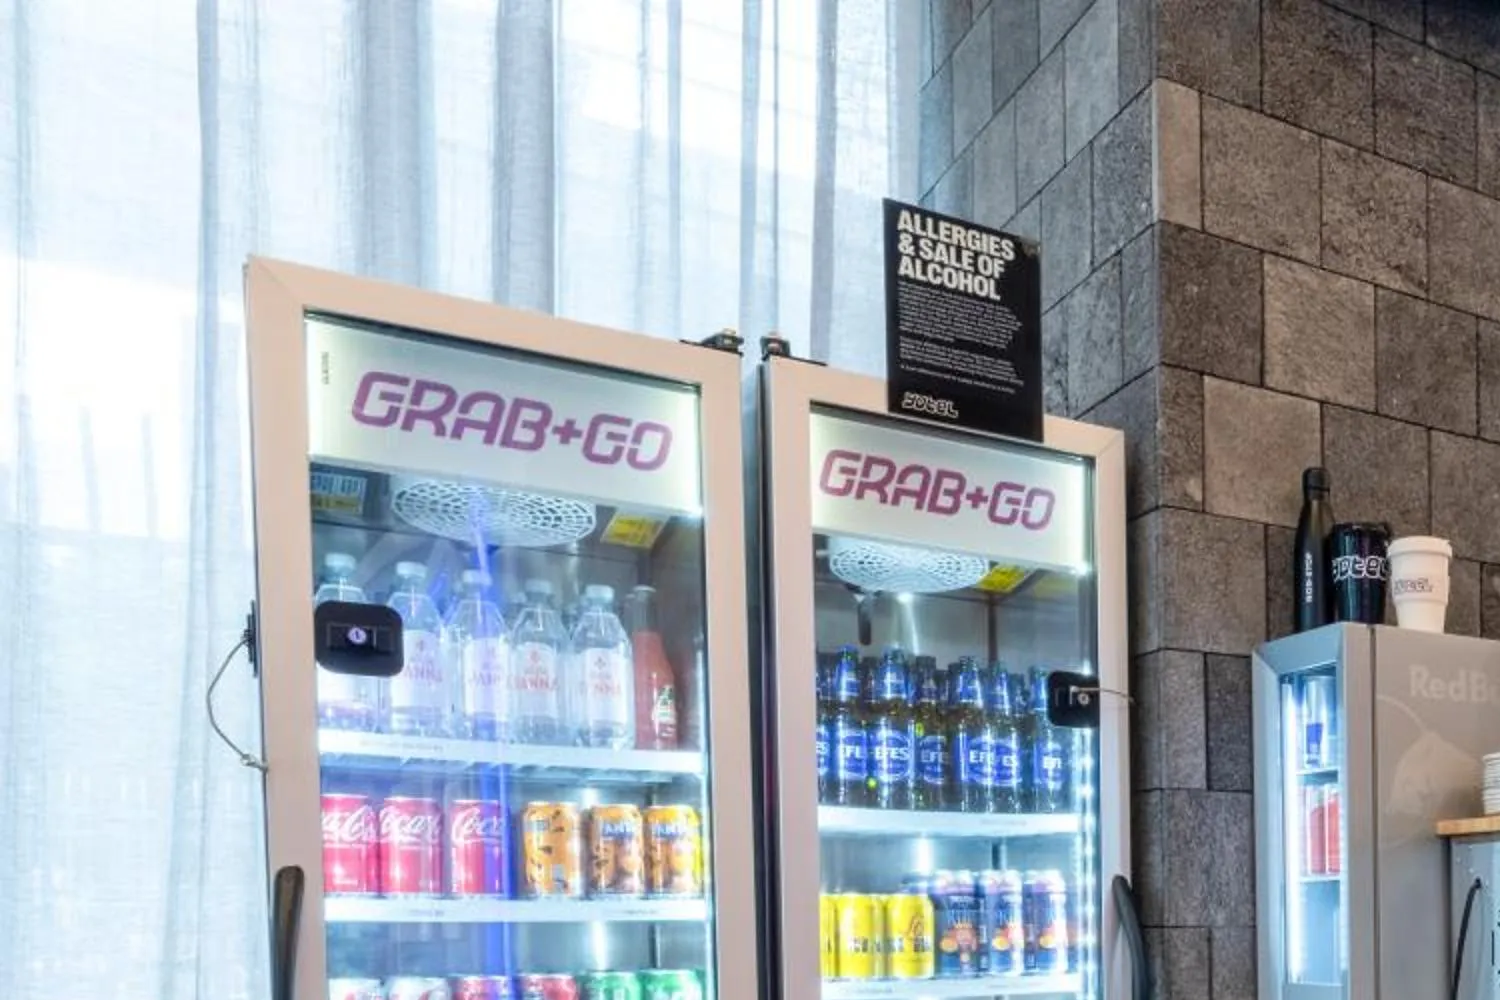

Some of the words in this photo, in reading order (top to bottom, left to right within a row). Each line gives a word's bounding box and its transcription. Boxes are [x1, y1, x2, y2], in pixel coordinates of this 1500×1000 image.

[897, 209, 1016, 261] ALLERGIES
[898, 232, 916, 257] &
[918, 237, 975, 273] SALE
[977, 254, 1005, 280] OF
[898, 255, 1001, 301] ALCOHOL
[351, 370, 674, 472] GRAB+GO
[820, 449, 1057, 531] GRAB+GO
